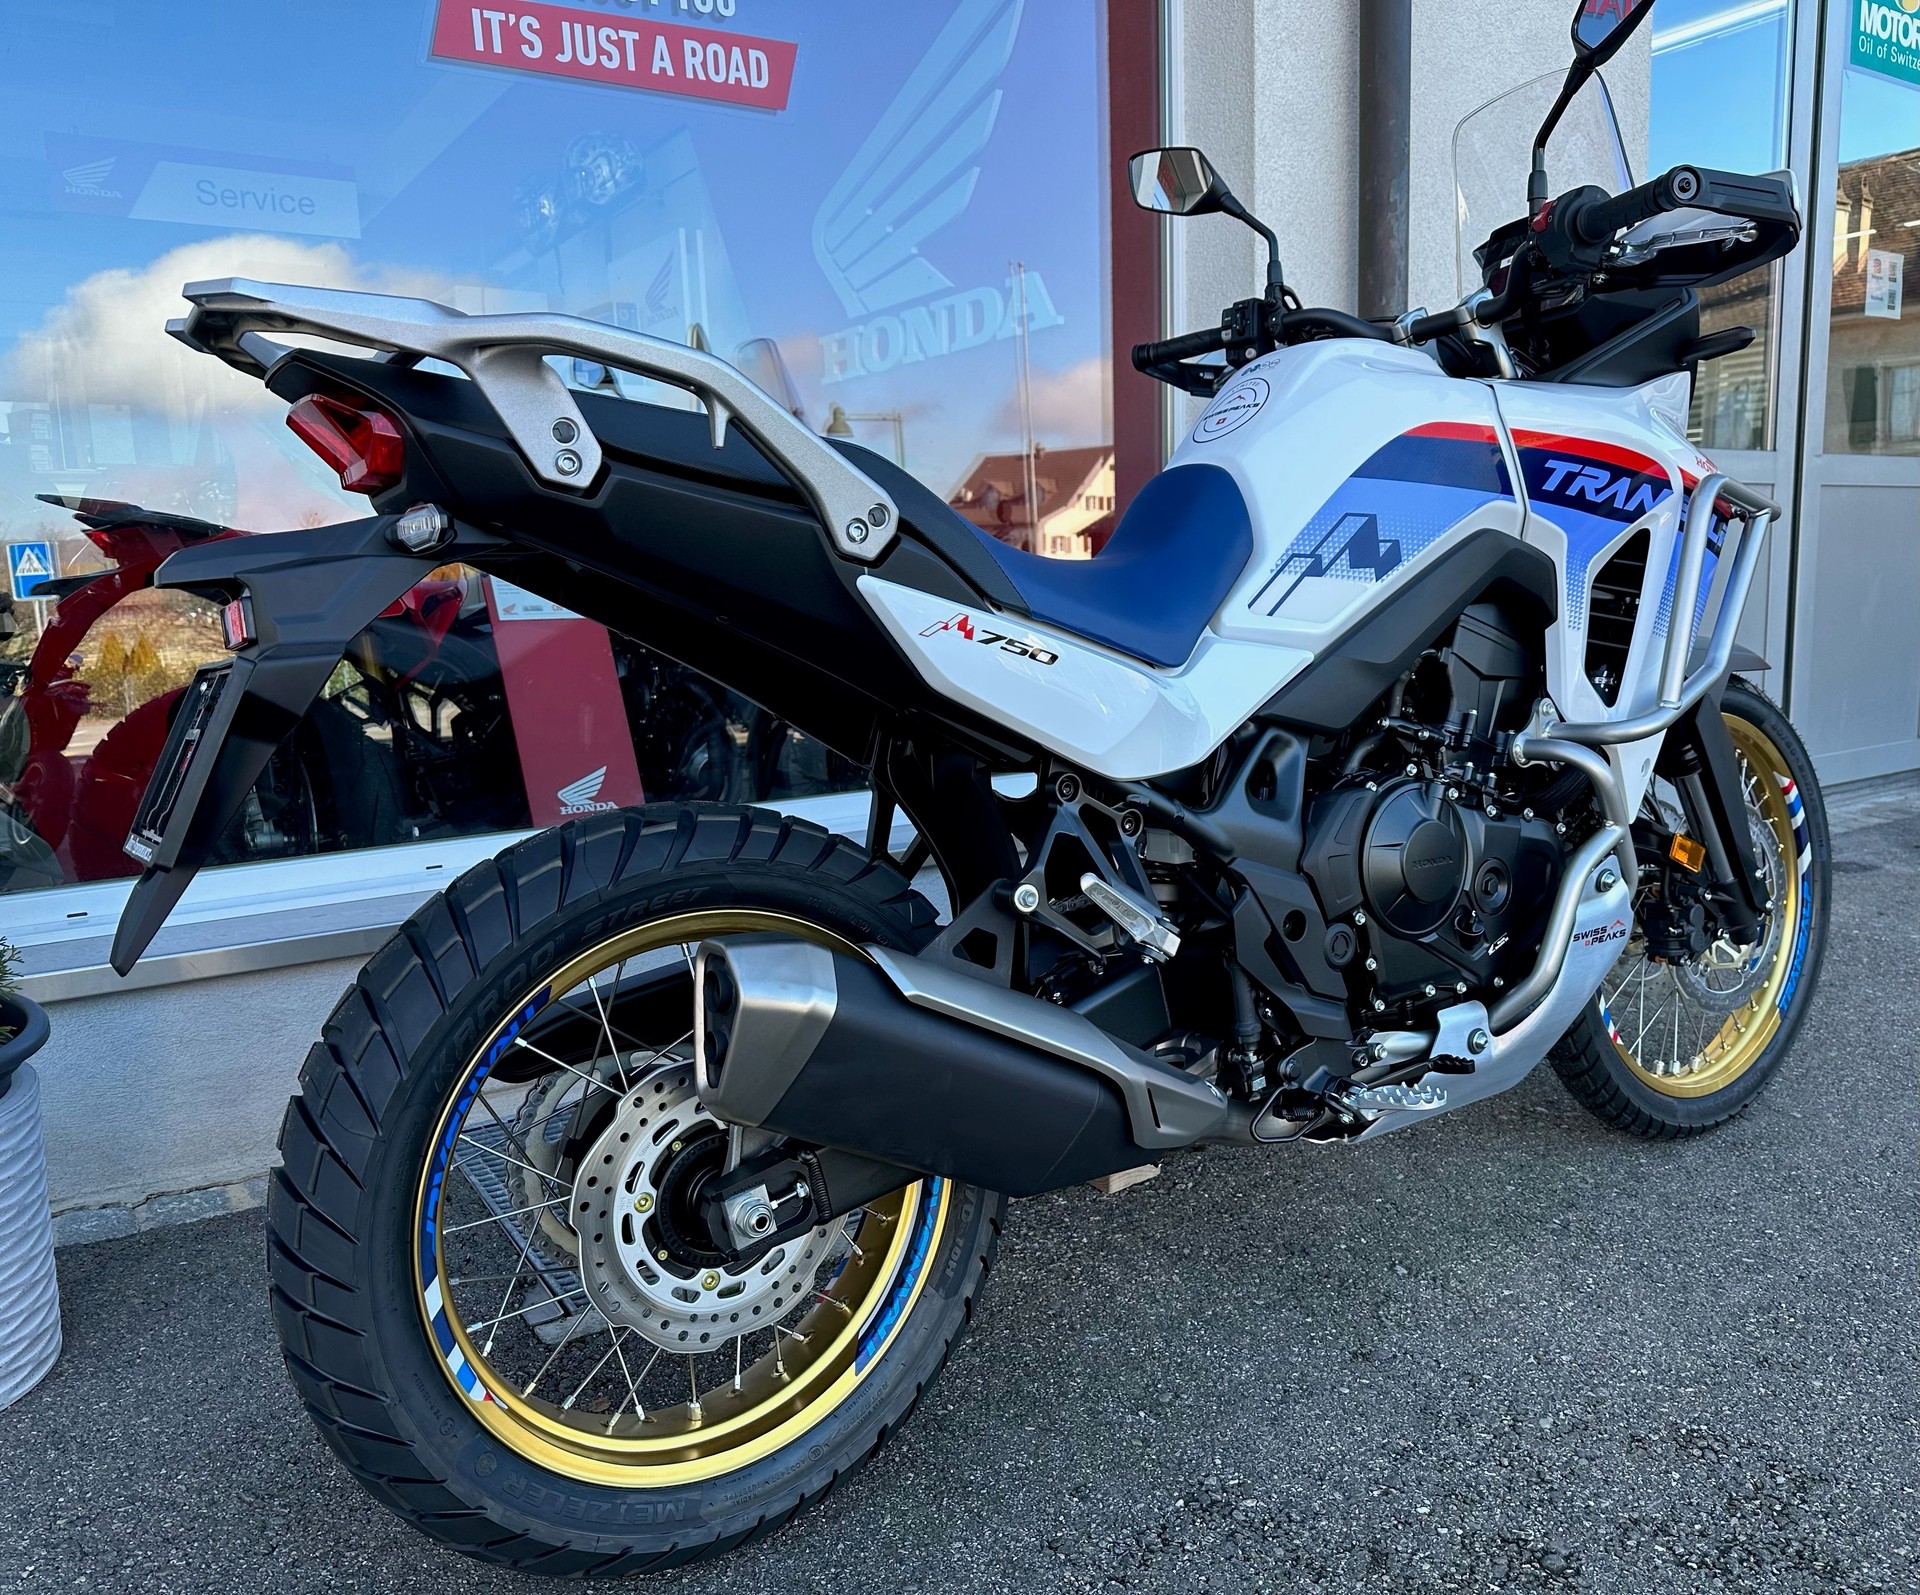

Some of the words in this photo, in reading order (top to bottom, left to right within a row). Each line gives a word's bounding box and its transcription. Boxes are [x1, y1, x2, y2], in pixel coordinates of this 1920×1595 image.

[471, 8, 542, 59] IT'S
[555, 21, 639, 72] JUST
[652, 35, 675, 77] A
[682, 38, 769, 89] ROAD
[1859, 35, 1873, 55] Oil
[1877, 44, 1888, 59] of
[65, 185, 123, 199] HONDA
[196, 179, 316, 215] Service
[819, 271, 1065, 385] HONDA
[977, 629, 1059, 666] 750
[560, 801, 619, 815] HONDA
[1412, 855, 1454, 870] HONDA
[581, 886, 711, 942] STREET
[1573, 925, 1608, 942] SWISS
[1590, 929, 1627, 946] PEAKS
[502, 1470, 686, 1527] METZELER
